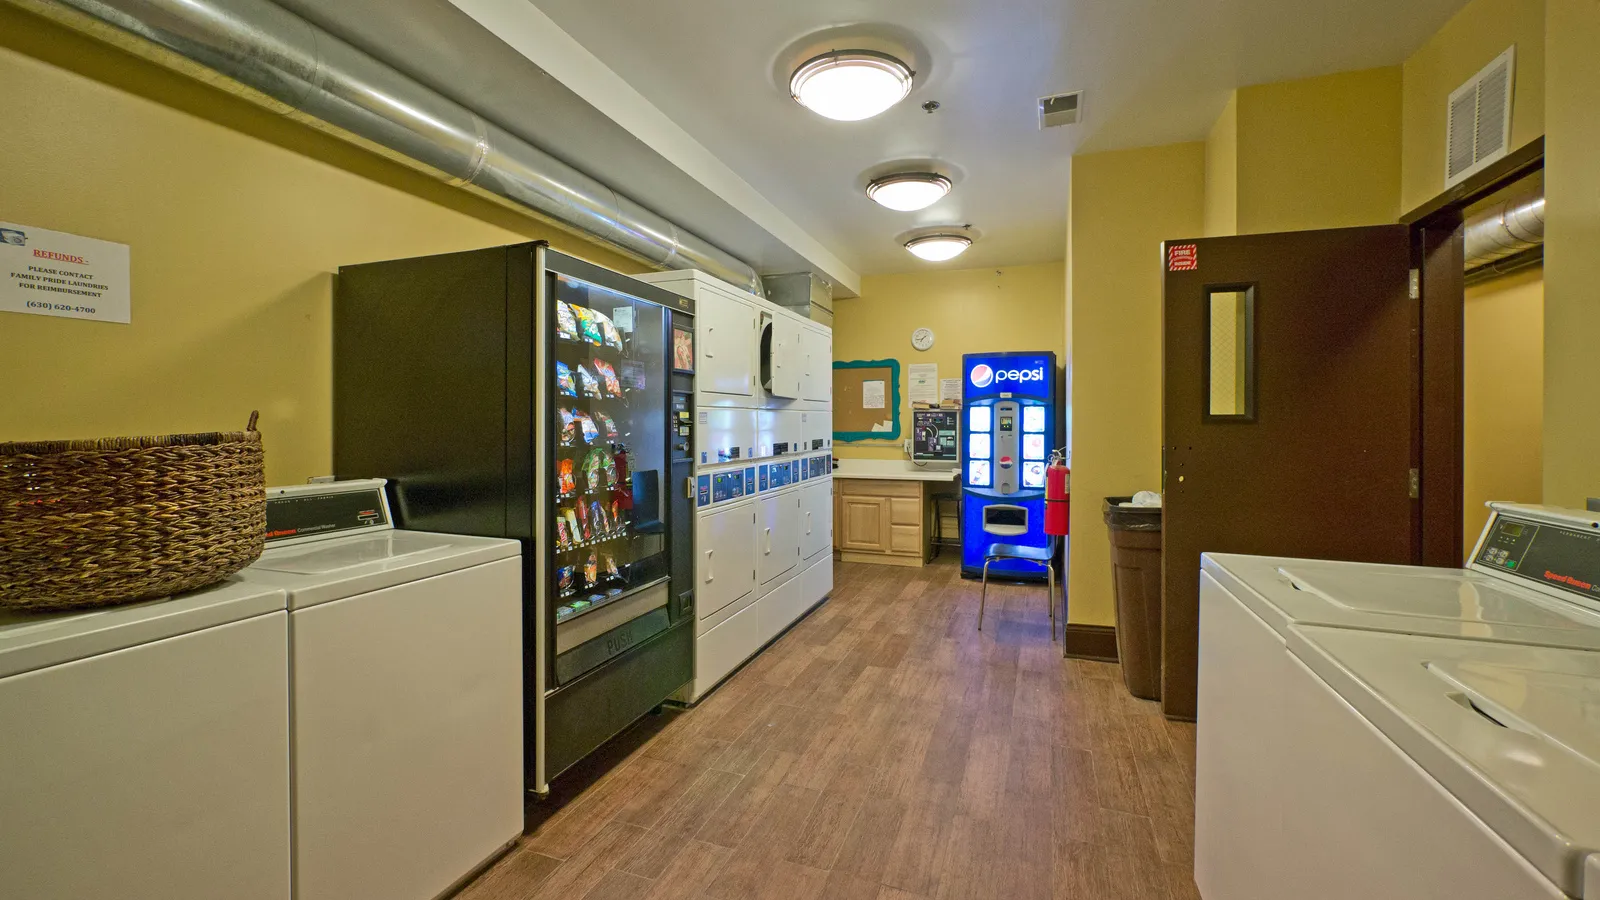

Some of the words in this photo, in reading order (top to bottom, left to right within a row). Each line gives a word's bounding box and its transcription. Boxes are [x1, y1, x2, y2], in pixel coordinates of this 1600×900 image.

[33, 249, 83, 264] REFUNDS
[28, 265, 57, 275] PLEASE
[58, 270, 94, 280] CONTACT
[10, 272, 41, 282] FAMILY
[43, 276, 67, 285] PRIDE
[68, 280, 109, 291] LAUNDRIES
[18, 282, 36, 290] FOR
[37, 285, 102, 298] REIMBURSEMENT
[26, 300, 52, 311] (630)
[54, 304, 96, 314] 620-4700
[995, 366, 1044, 384] pepsi
[1544, 570, 1567, 582] Speed
[1567, 577, 1591, 589] Queen
